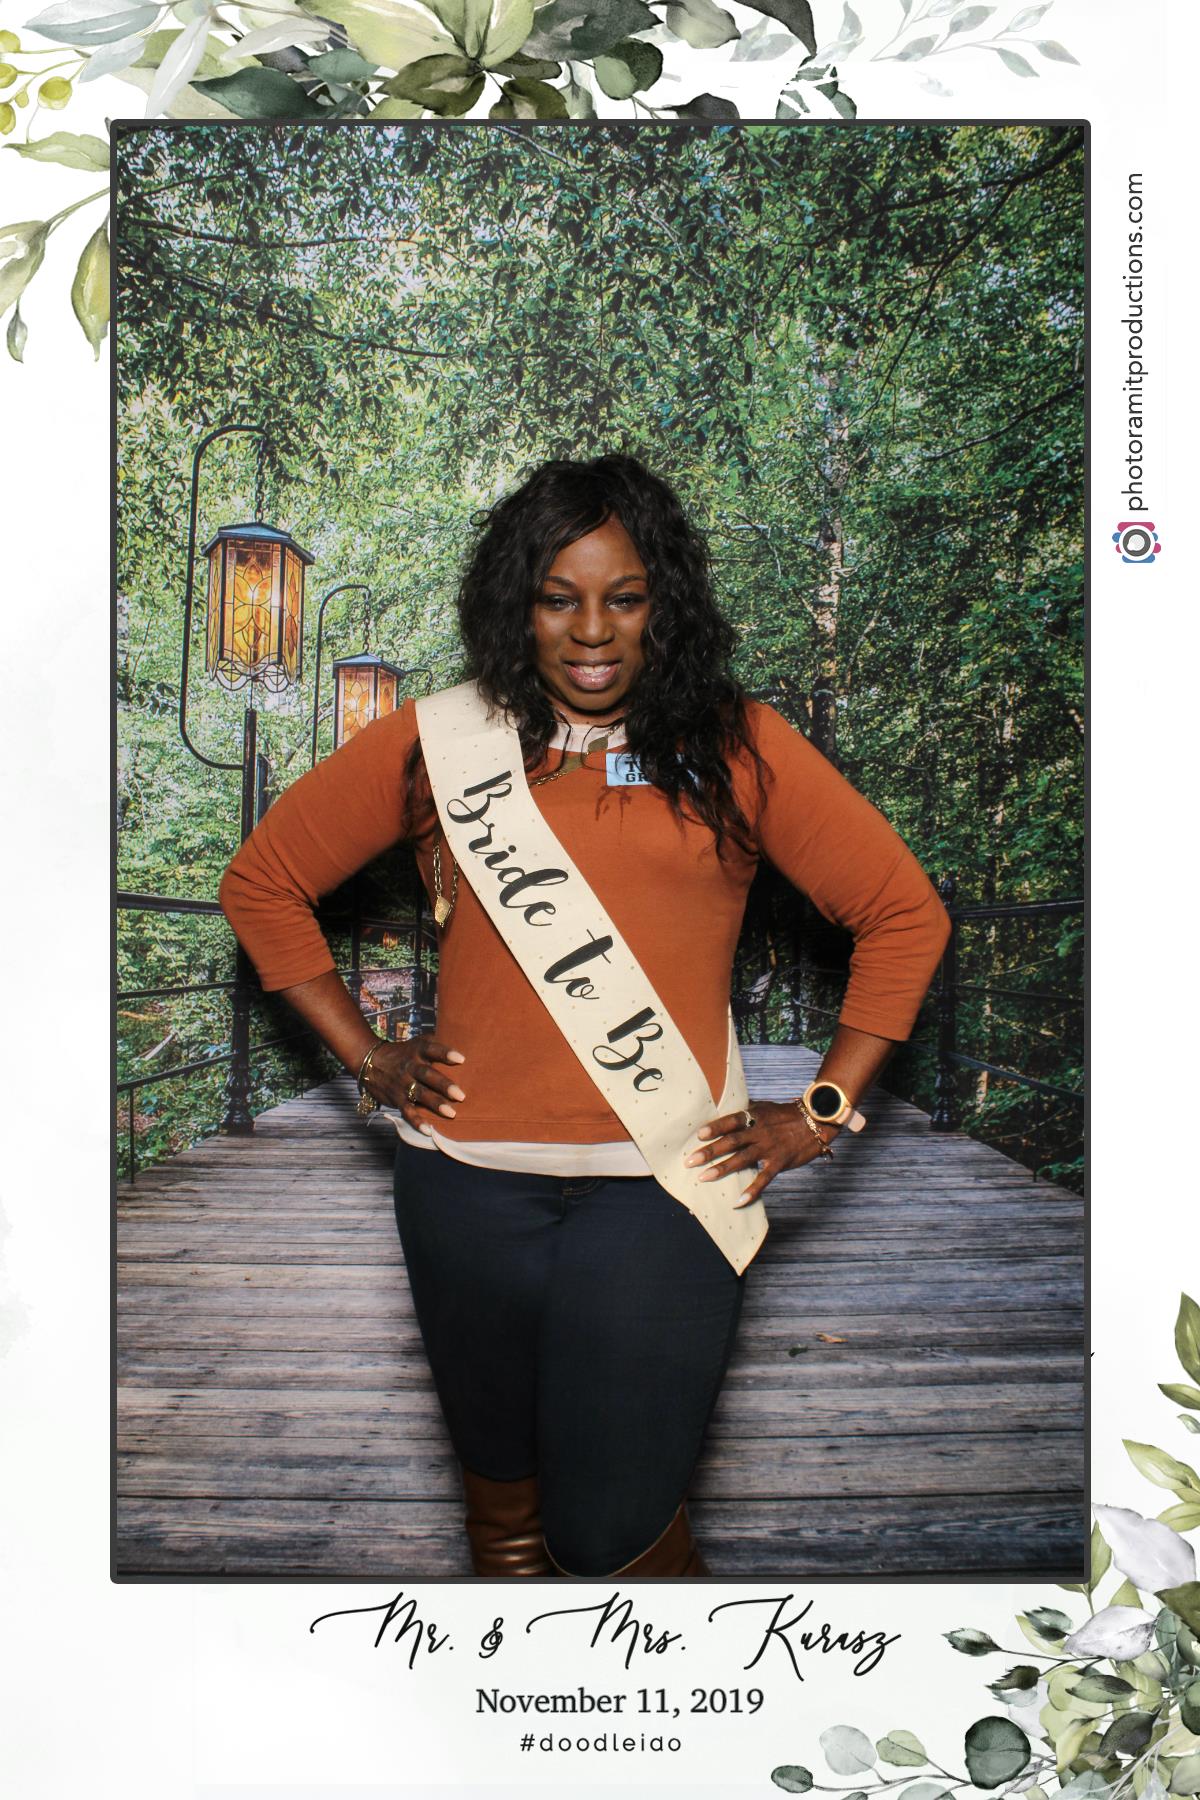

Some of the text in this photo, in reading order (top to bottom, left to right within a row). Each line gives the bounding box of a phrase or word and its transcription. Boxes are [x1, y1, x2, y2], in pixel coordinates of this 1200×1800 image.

[446, 770, 664, 1092] Bride to Be
